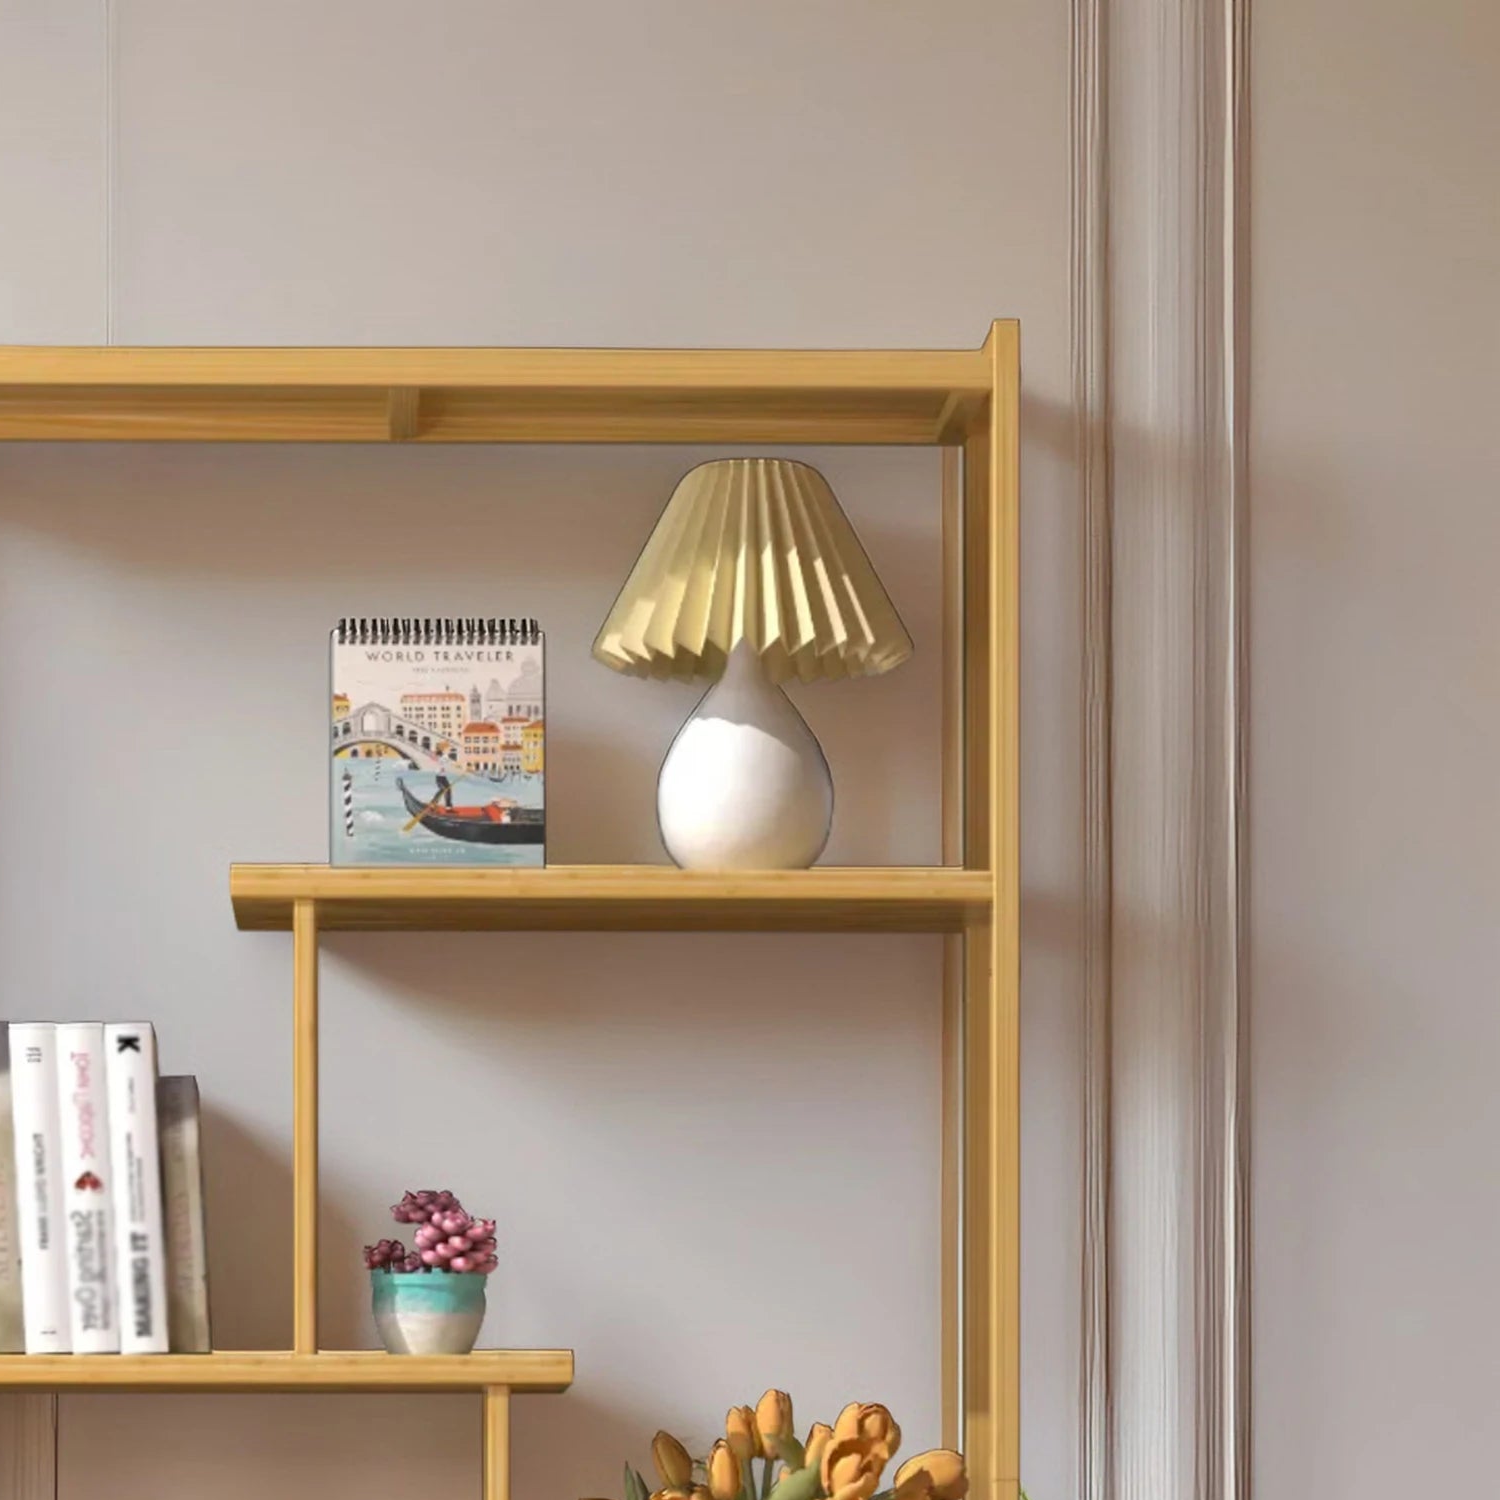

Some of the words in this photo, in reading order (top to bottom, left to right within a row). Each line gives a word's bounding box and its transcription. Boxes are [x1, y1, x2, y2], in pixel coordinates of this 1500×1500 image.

[365, 651, 425, 662] WORLD
[434, 651, 514, 662] TRAVELER
[129, 1232, 148, 1251] IT
[131, 1258, 153, 1338] MAKING
